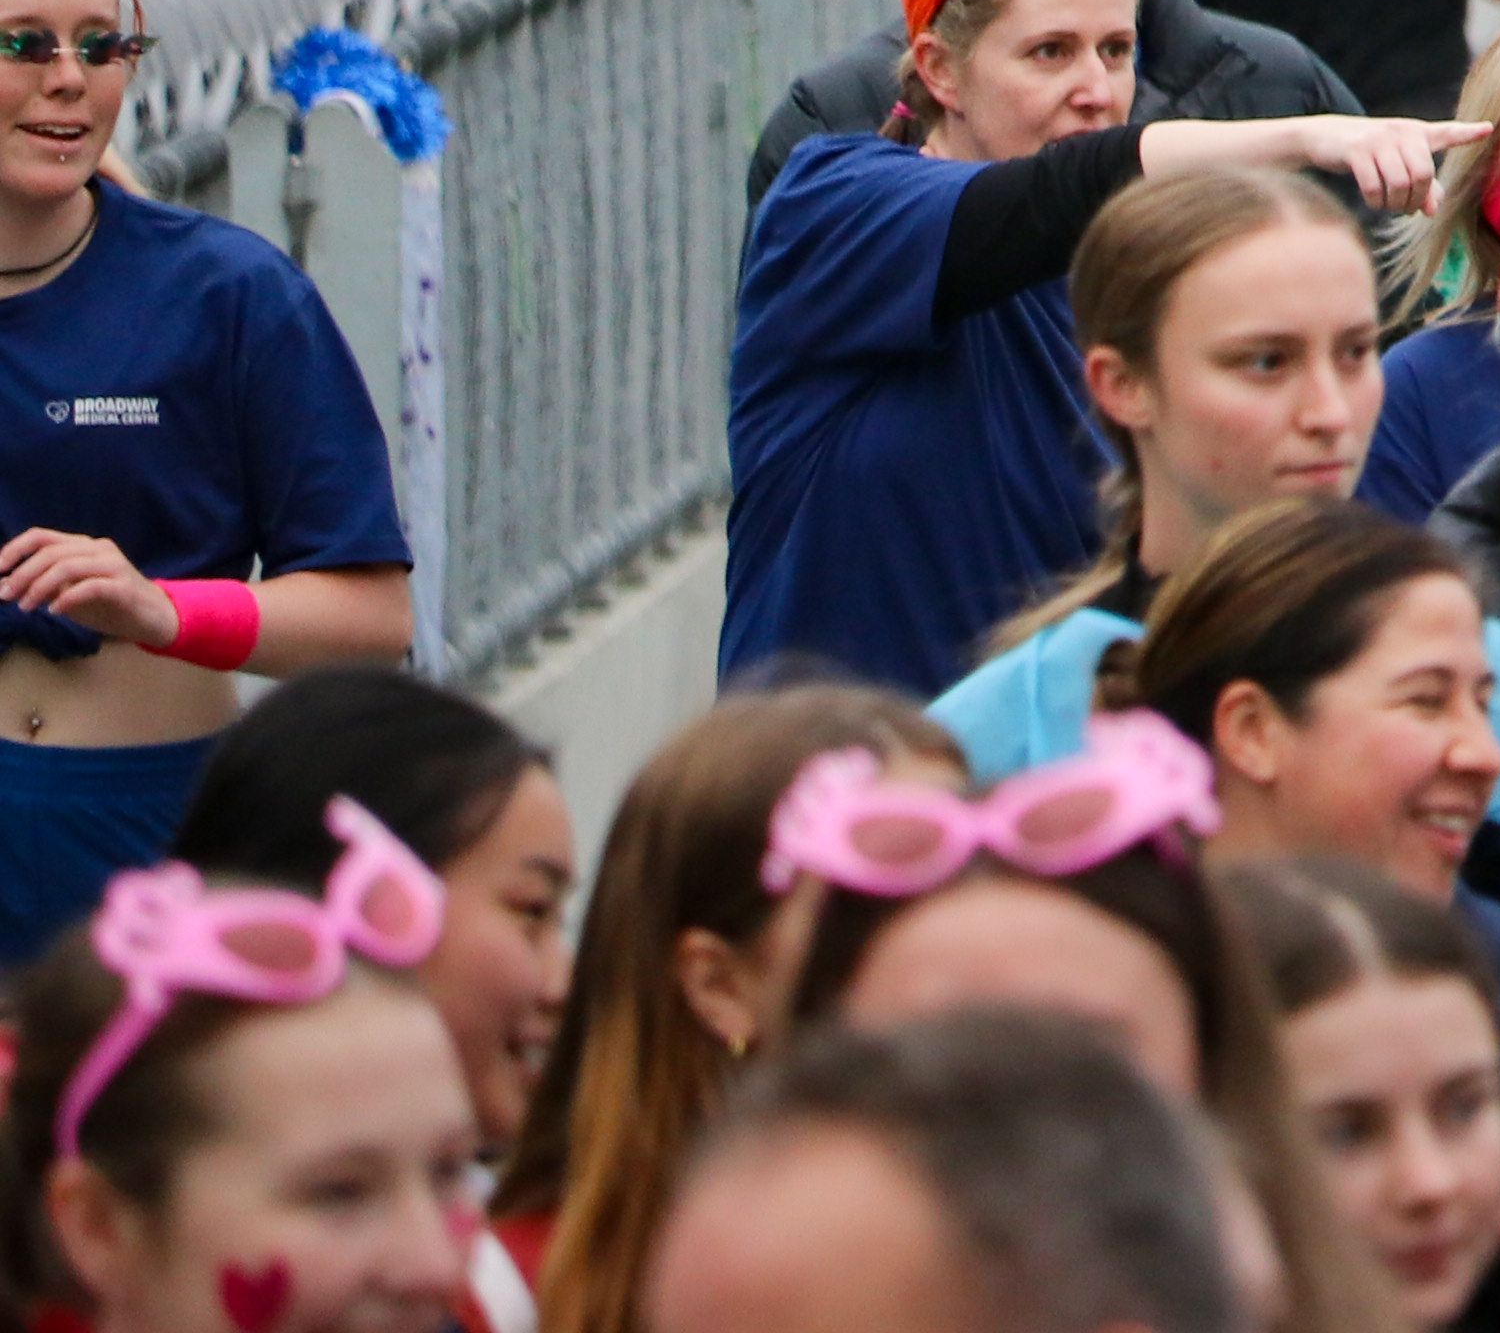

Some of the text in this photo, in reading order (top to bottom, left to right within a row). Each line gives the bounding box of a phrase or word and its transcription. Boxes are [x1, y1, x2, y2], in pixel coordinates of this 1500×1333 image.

[74, 396, 159, 414] BROADWAY
[74, 412, 160, 426] MEDICAL CENTRE
